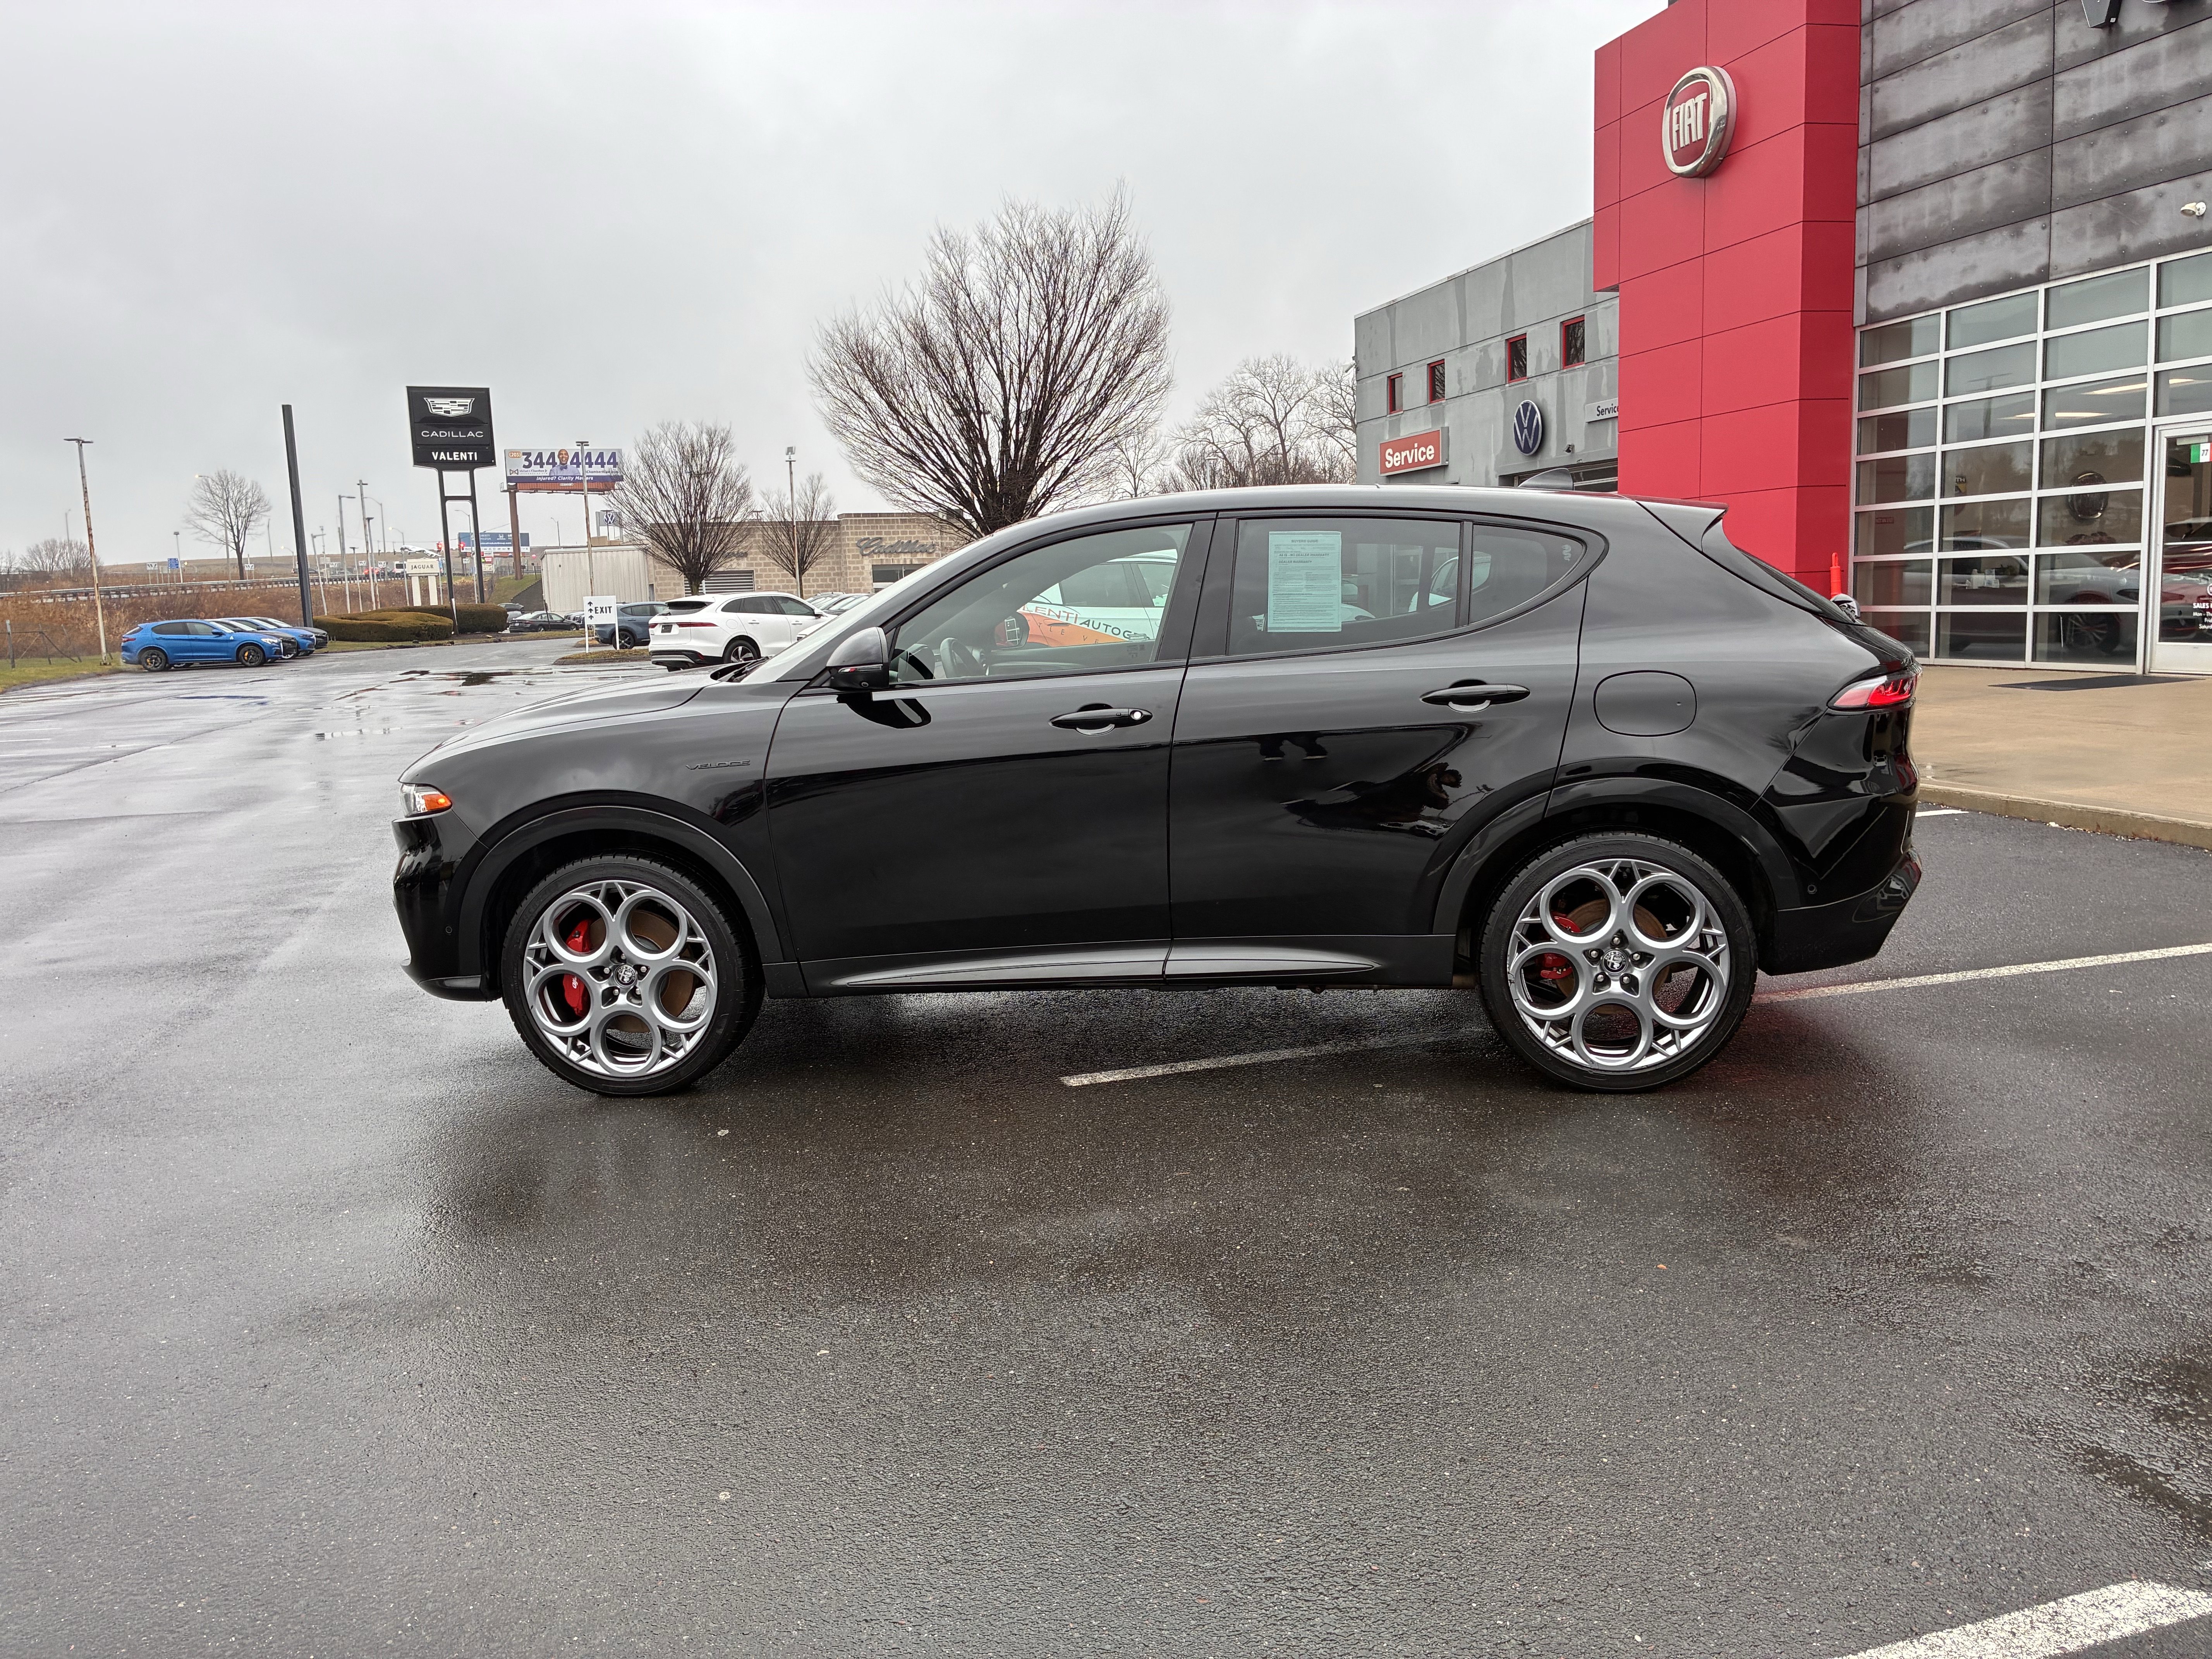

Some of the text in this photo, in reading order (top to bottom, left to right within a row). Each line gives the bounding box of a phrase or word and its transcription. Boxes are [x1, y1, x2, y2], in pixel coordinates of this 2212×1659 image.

[1672, 92, 1707, 151] FIAT
[432, 452, 477, 460] VALENTI
[522, 452, 557, 469] 344
[570, 452, 618, 469] 4444
[1385, 443, 1435, 468] Service
[856, 537, 936, 556] Cadillac
[685, 760, 750, 770] VELOCE
